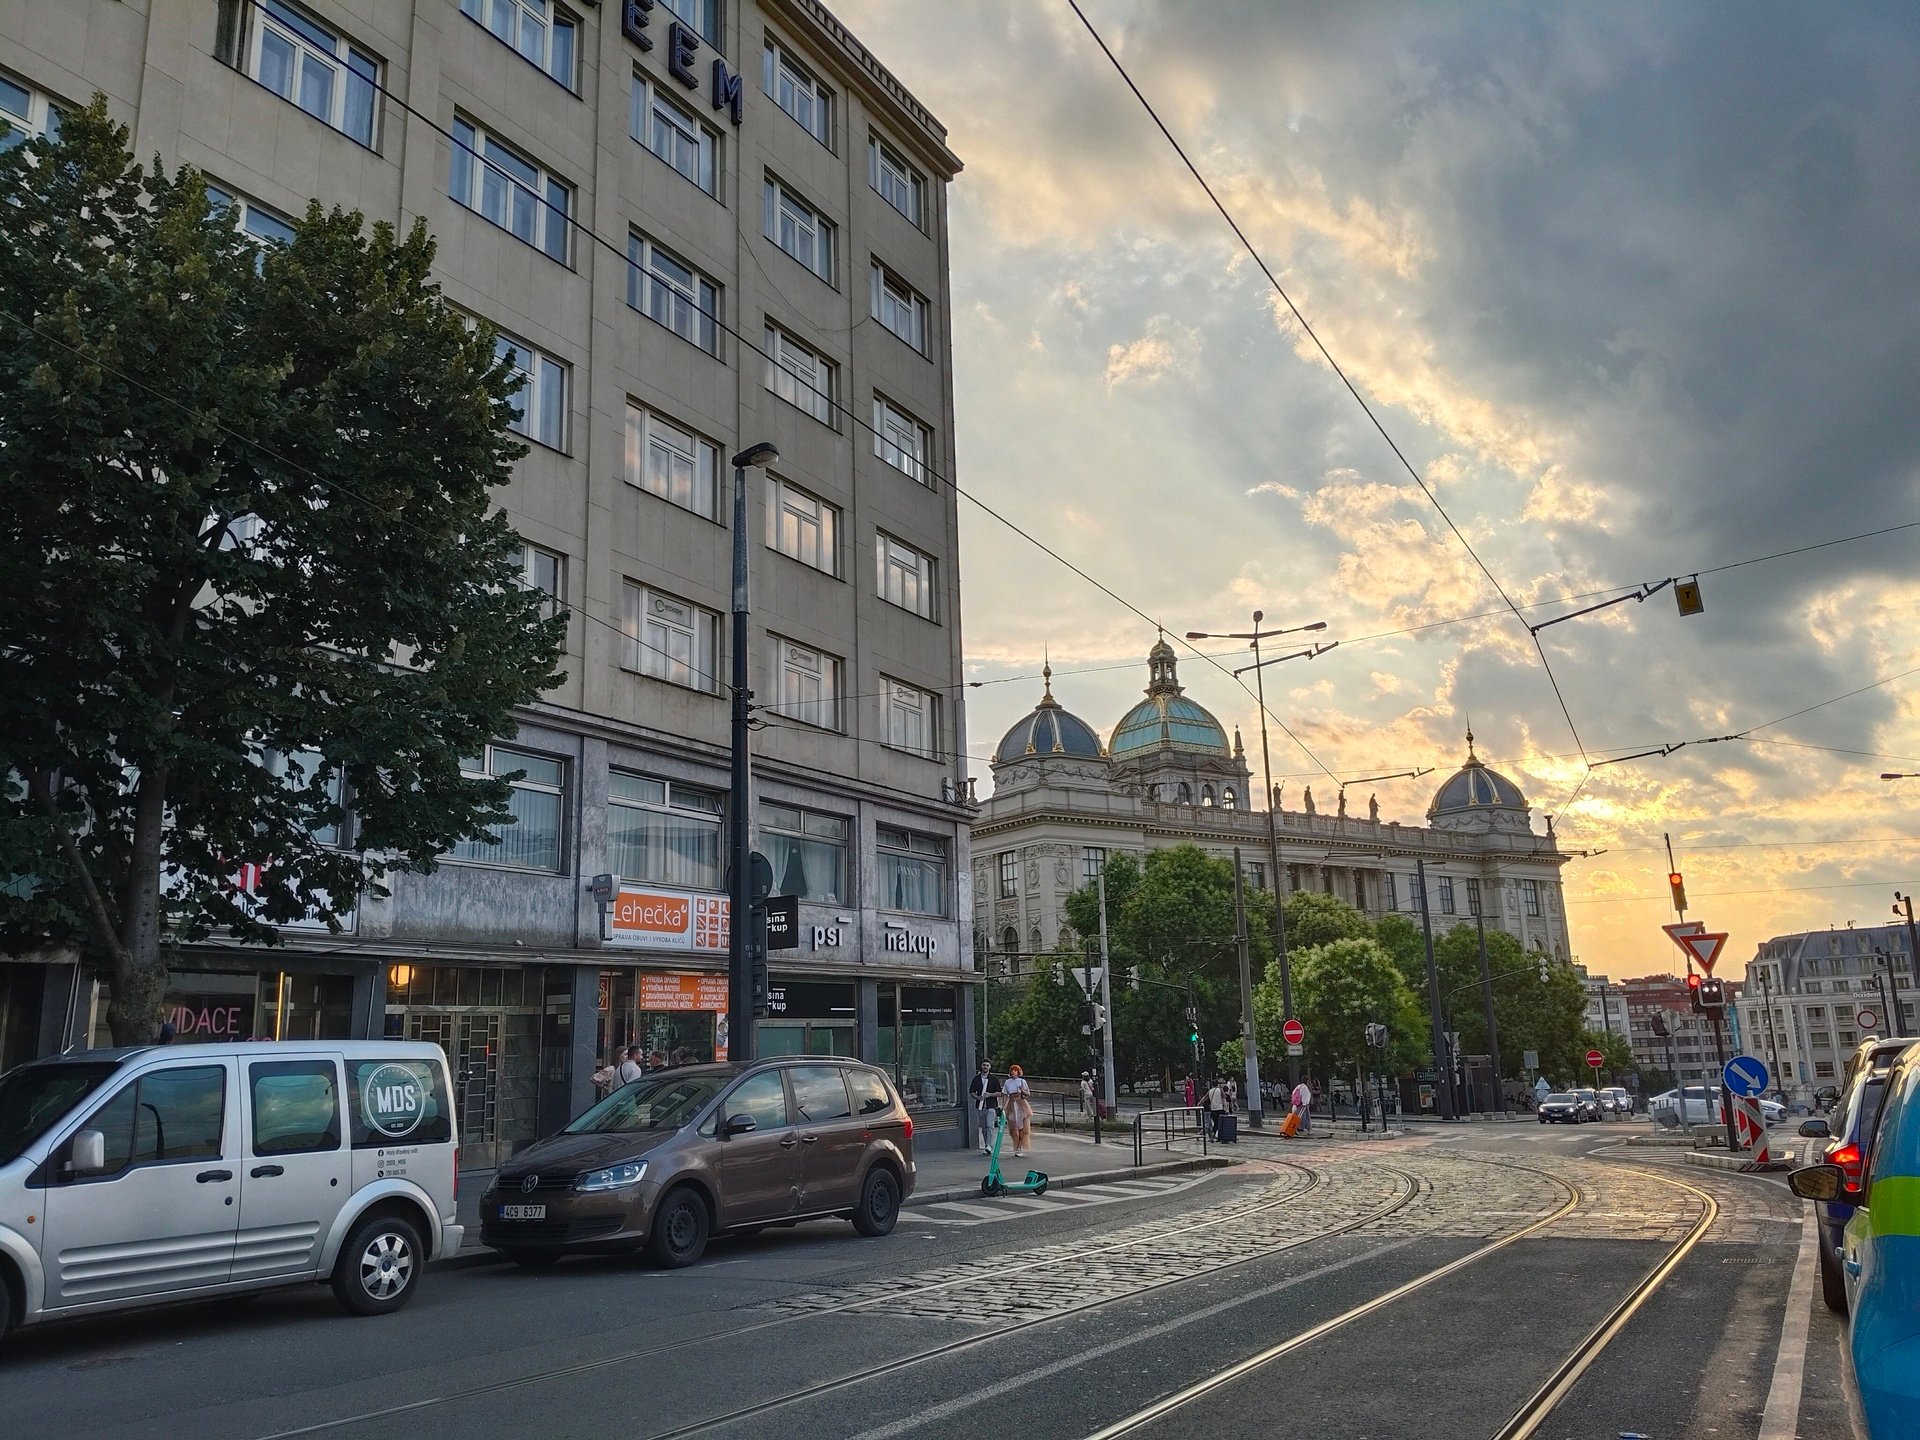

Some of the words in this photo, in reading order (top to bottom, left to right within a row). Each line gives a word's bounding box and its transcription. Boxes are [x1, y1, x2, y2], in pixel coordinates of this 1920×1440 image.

[582, 0, 743, 125] EEM
[376, 1085, 416, 1113] MDS
[505, 1206, 519, 1217] 4C9
[523, 1206, 542, 1217] 6377
